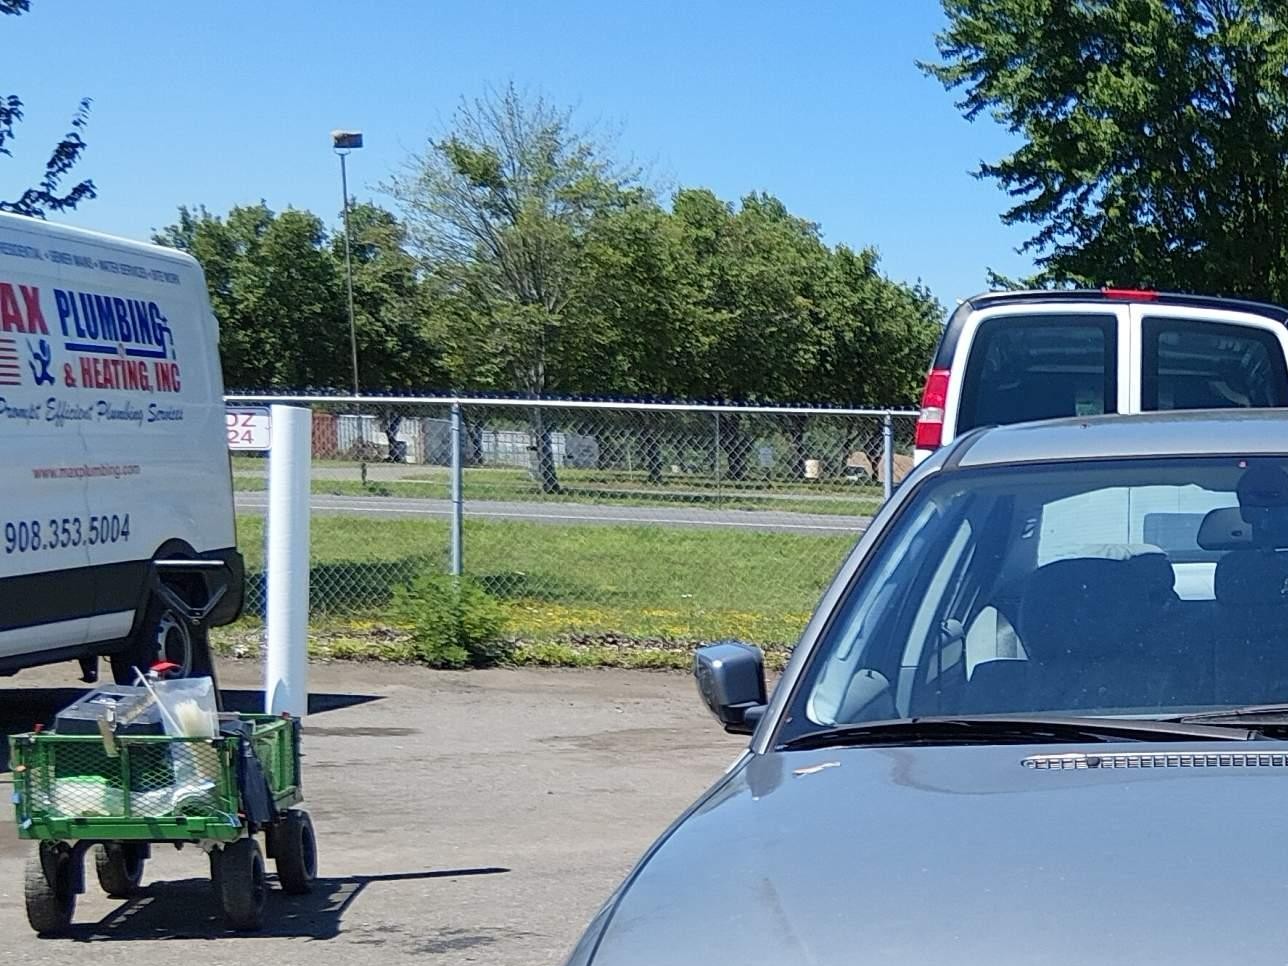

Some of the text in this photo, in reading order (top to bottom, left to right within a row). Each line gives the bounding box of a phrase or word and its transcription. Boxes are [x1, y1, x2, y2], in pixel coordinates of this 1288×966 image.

[53, 288, 166, 347] PLUMBING
[63, 362, 77, 388] &
[154, 362, 181, 392] INC
[227, 429, 255, 444] 24
[5, 513, 130, 554] 908.353.5004
